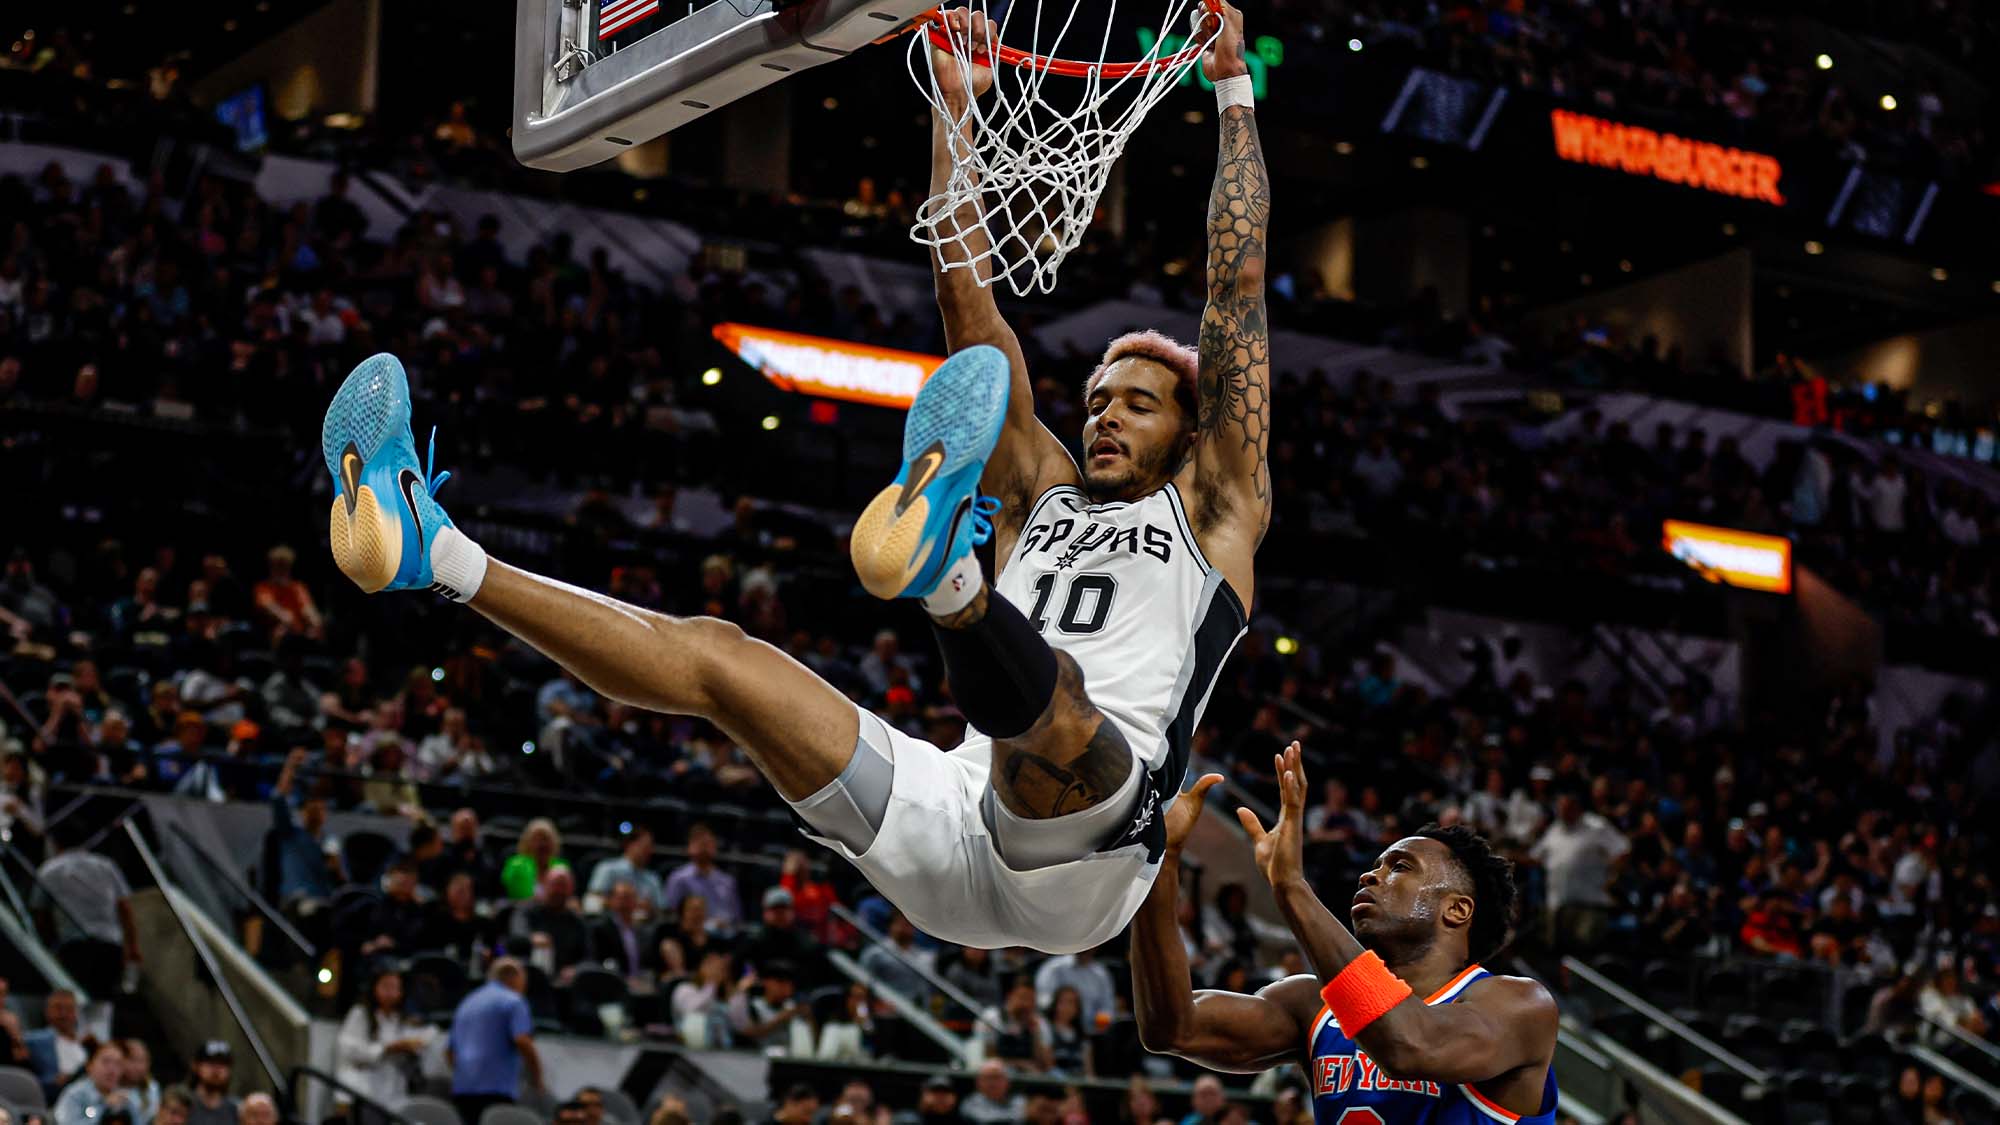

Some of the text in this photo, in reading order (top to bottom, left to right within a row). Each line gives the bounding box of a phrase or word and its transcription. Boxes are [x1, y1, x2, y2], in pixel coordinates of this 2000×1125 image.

[1551, 108, 1785, 206] WHATABURGER
[1020, 519, 1173, 571] SPURS
[1028, 571, 1119, 636] 10
[1313, 1054, 1356, 1099] NEW
